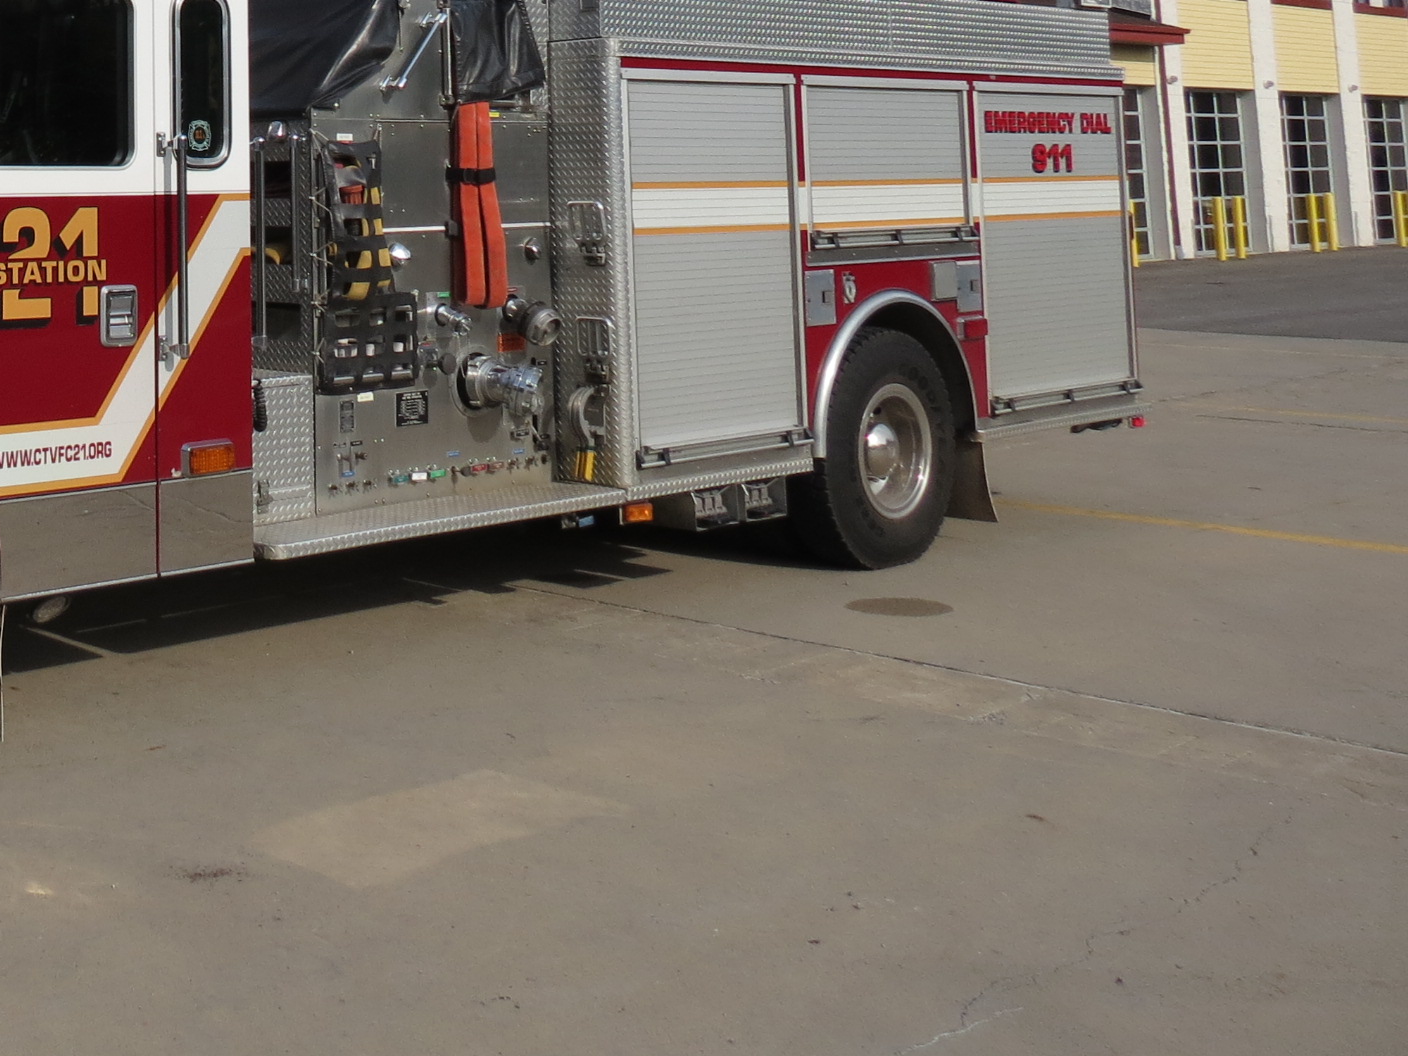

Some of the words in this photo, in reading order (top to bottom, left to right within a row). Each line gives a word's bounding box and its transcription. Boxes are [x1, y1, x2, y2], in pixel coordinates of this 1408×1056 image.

[984, 110, 1075, 133] EMERGENCY
[1080, 112, 1112, 134] DIAL
[1031, 143, 1073, 173] 911
[2, 206, 99, 320] 21
